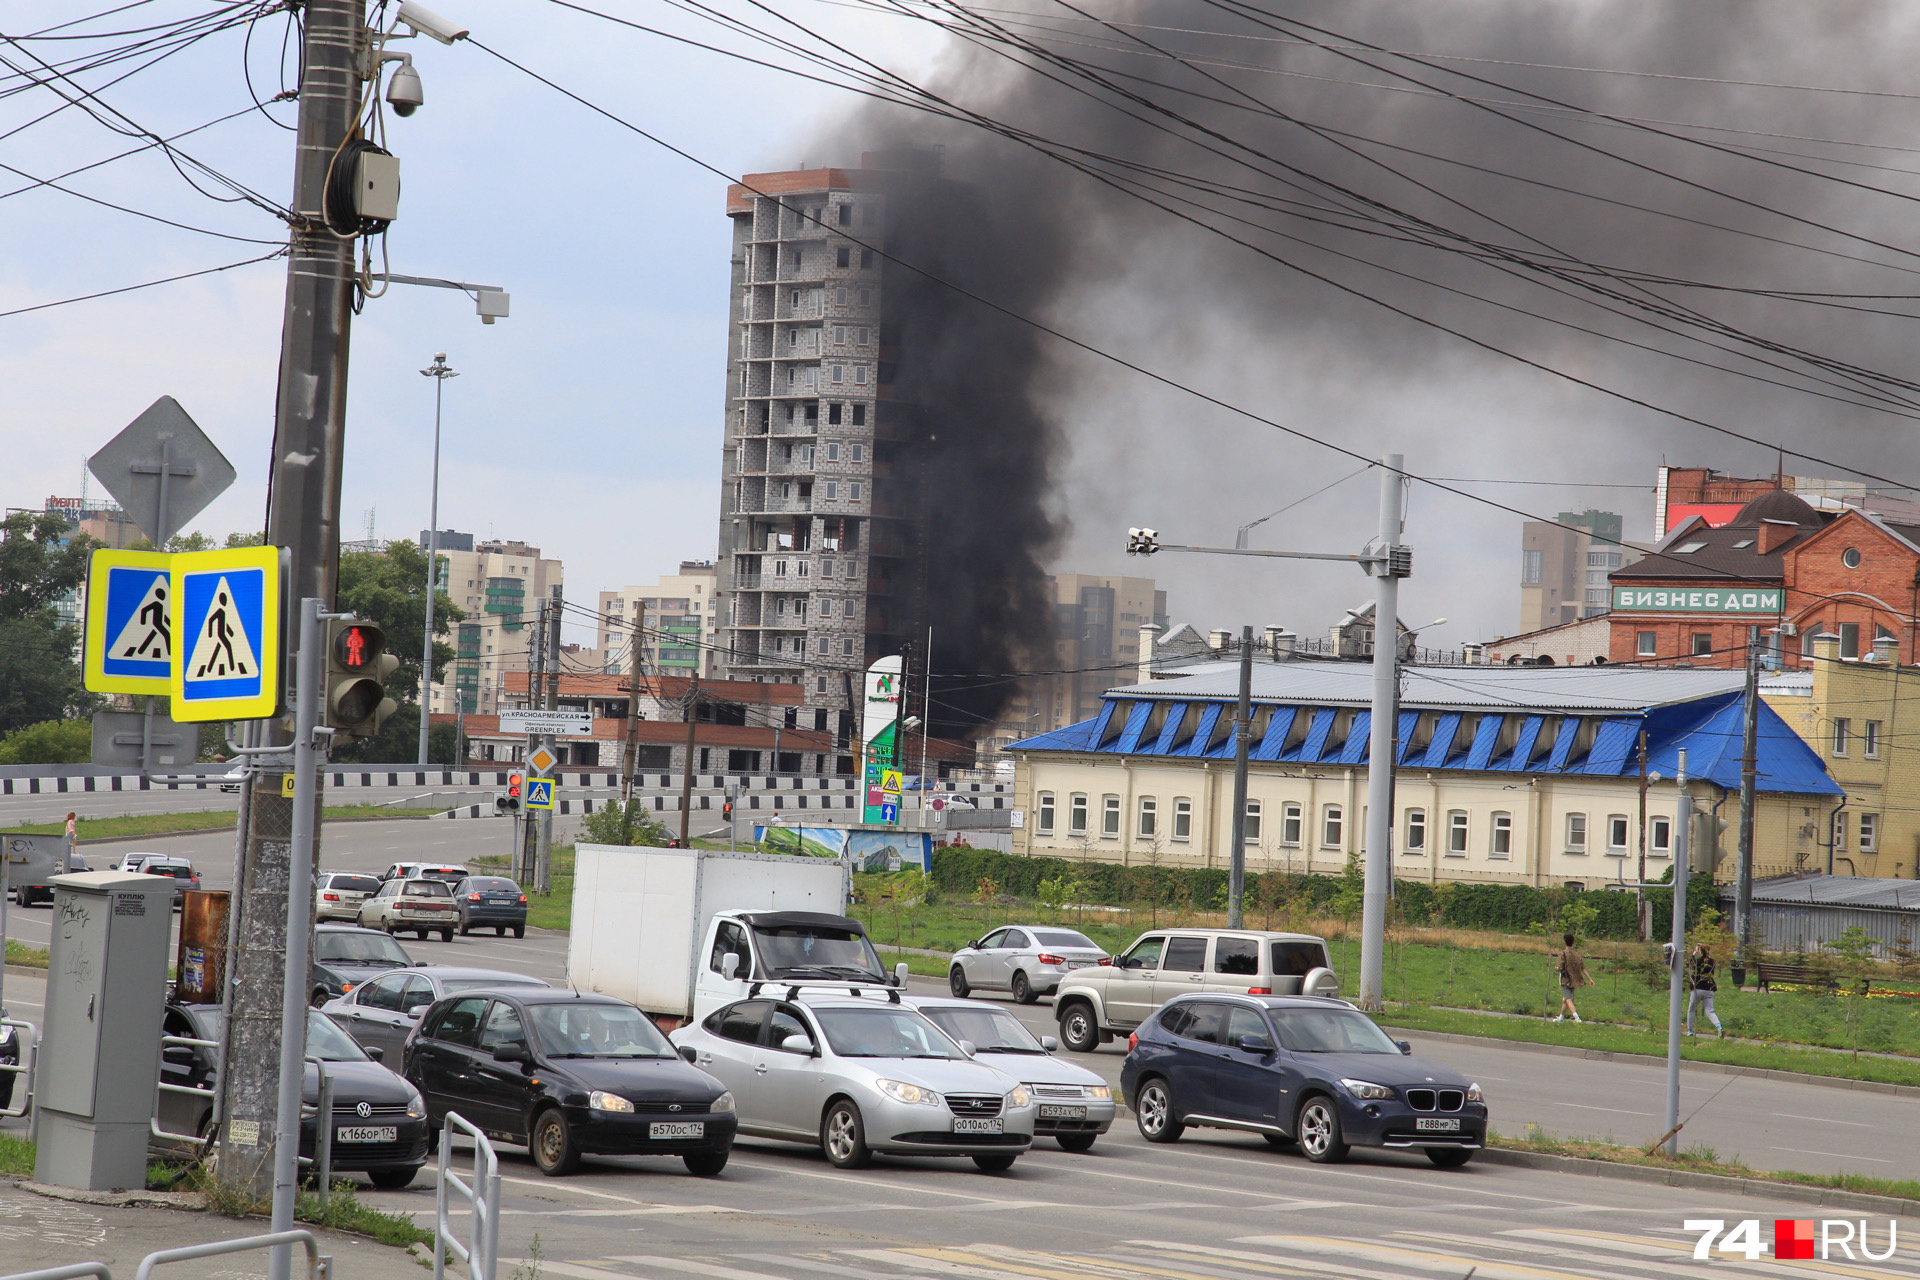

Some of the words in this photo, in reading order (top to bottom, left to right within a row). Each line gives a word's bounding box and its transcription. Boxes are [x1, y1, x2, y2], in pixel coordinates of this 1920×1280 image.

[1620, 592, 1718, 607] БИЗНЕС
[1724, 593, 1777, 610] ДОМ
[511, 711, 580, 719] КРАСНОАРМЕЙСКАЯ
[1043, 1106, 1072, 1116] В593АХ
[1074, 1107, 1086, 1115] 174
[653, 1124, 687, 1135] В570ОС
[690, 1124, 702, 1132] 174
[956, 1120, 988, 1130] О010АО
[989, 1120, 1001, 1128] 174
[1420, 1120, 1449, 1129] Т888МР
[341, 1128, 379, 1140] К166ОР
[381, 1128, 395, 1137] 174
